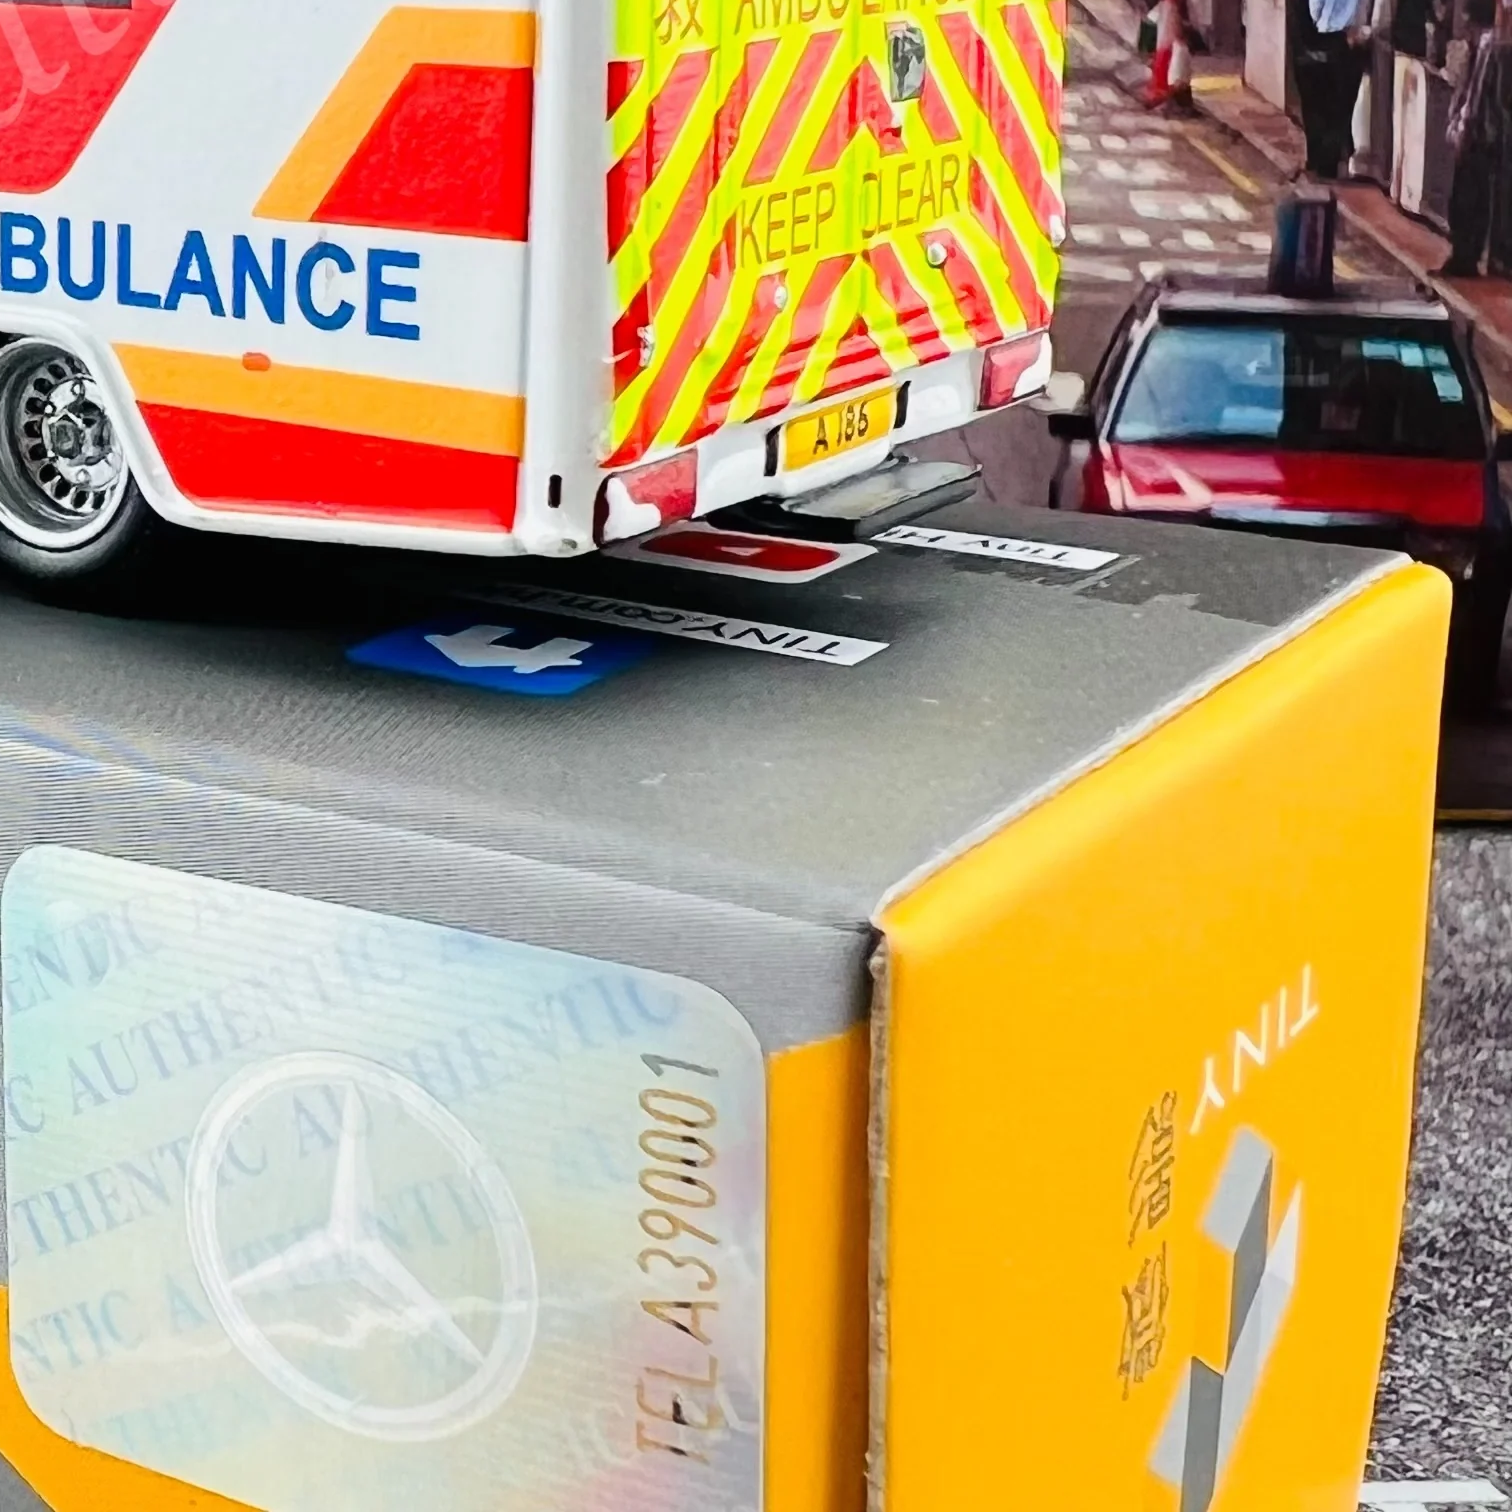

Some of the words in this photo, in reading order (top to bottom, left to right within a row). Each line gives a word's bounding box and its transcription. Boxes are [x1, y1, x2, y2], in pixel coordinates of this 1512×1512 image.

[738, 181, 837, 269] KEEP
[860, 153, 961, 241] CLEAR
[1189, 963, 1320, 1135] TINY
